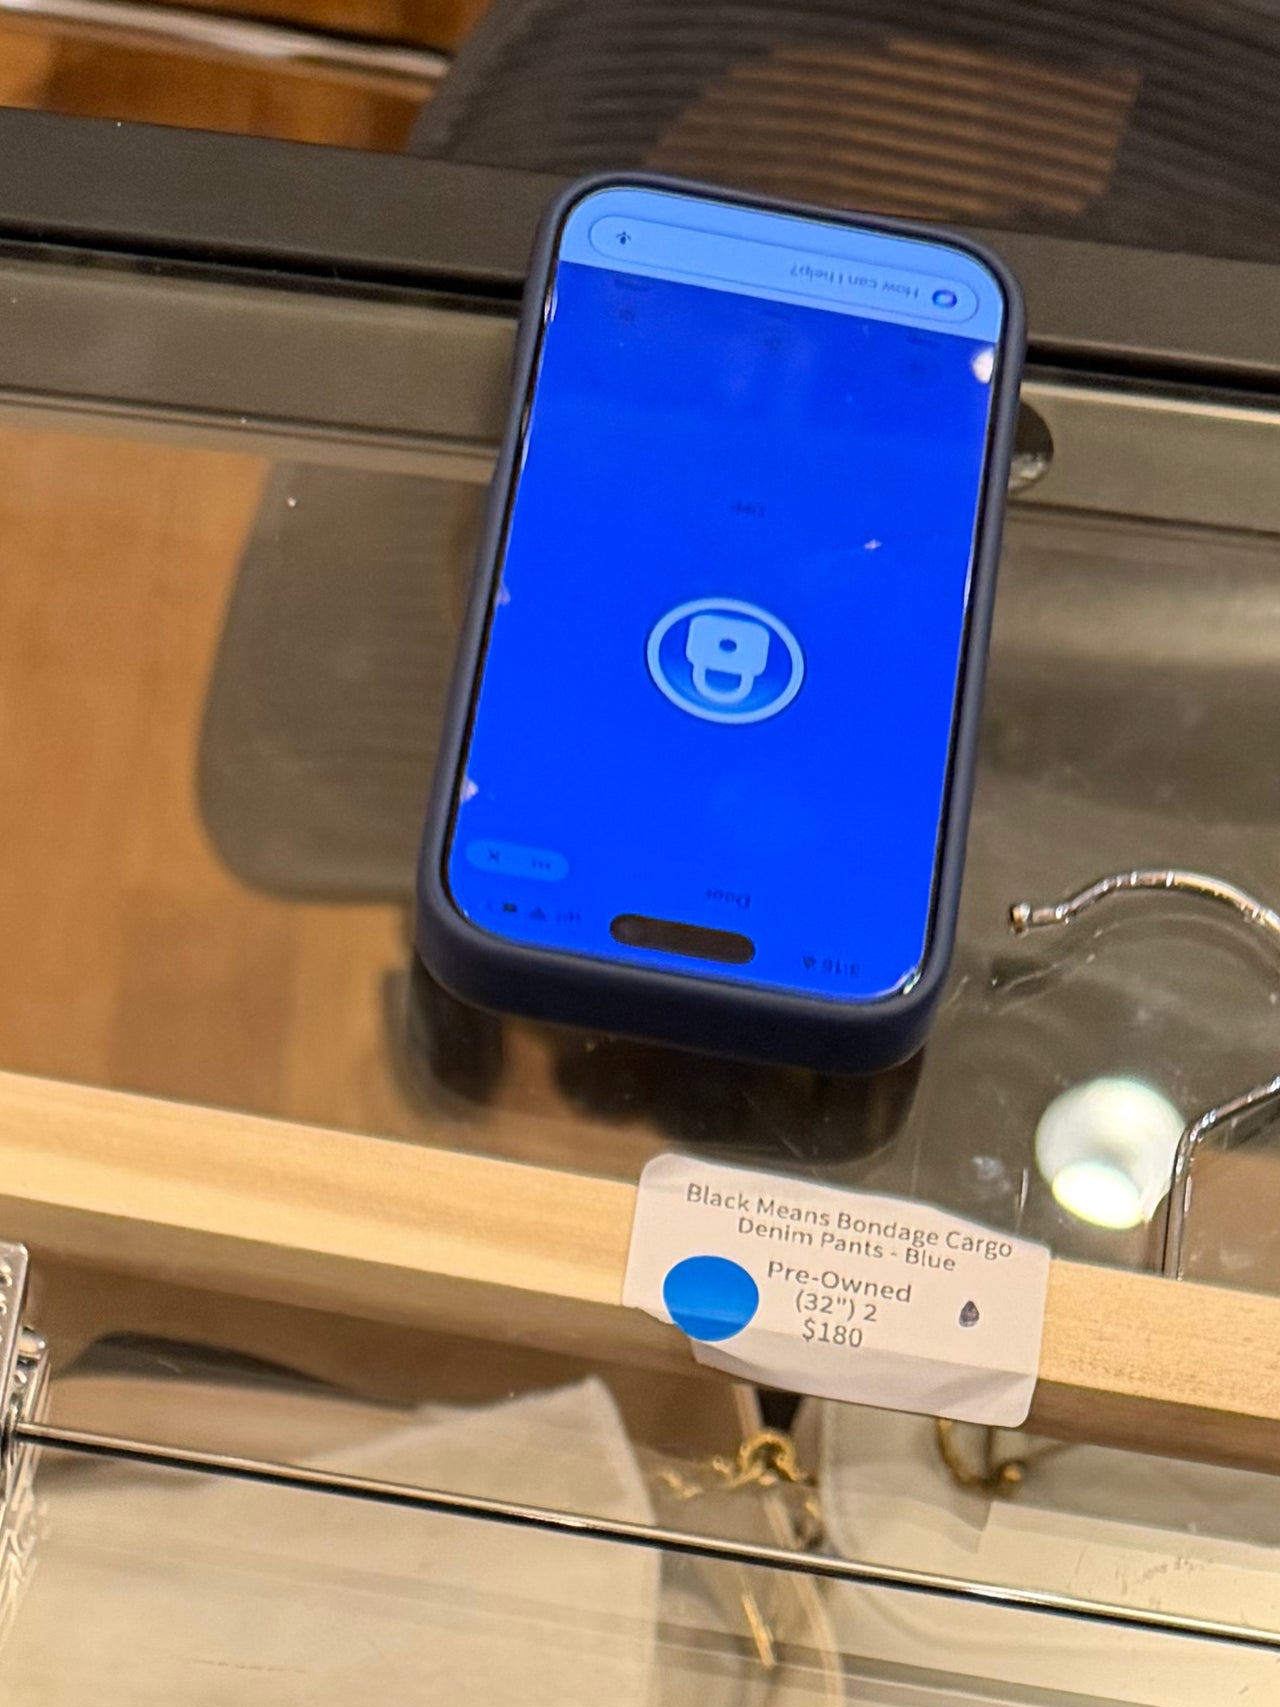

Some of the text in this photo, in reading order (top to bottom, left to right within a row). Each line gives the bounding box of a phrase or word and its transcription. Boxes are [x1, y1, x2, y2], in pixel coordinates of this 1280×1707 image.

[847, 273, 879, 289] can
[686, 1182, 1013, 1261] Black Means Bondage Cargo
[737, 1216, 814, 1246] Denim
[820, 1232, 884, 1259] Pants
[905, 1247, 956, 1272] Blue
[767, 1260, 912, 1303] Pre-Owned
[795, 1289, 878, 1322] (32") 2
[801, 1317, 863, 1348] $180
